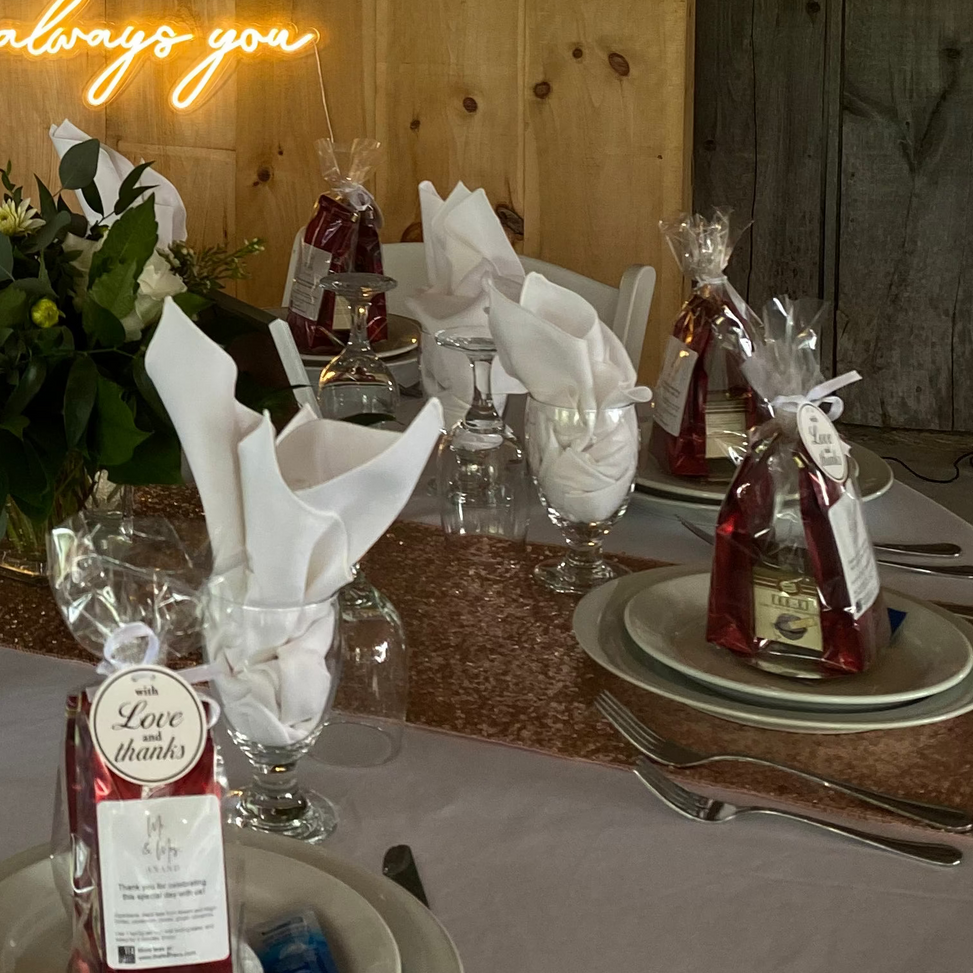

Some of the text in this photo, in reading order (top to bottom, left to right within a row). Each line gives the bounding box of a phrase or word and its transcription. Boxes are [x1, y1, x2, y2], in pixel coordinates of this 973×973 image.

[171, 25, 315, 110] you
[135, 685, 159, 697] with
[112, 699, 184, 731] Love
[142, 730, 163, 743] and
[113, 736, 186, 764] thanks
[118, 883, 140, 892] Thank
